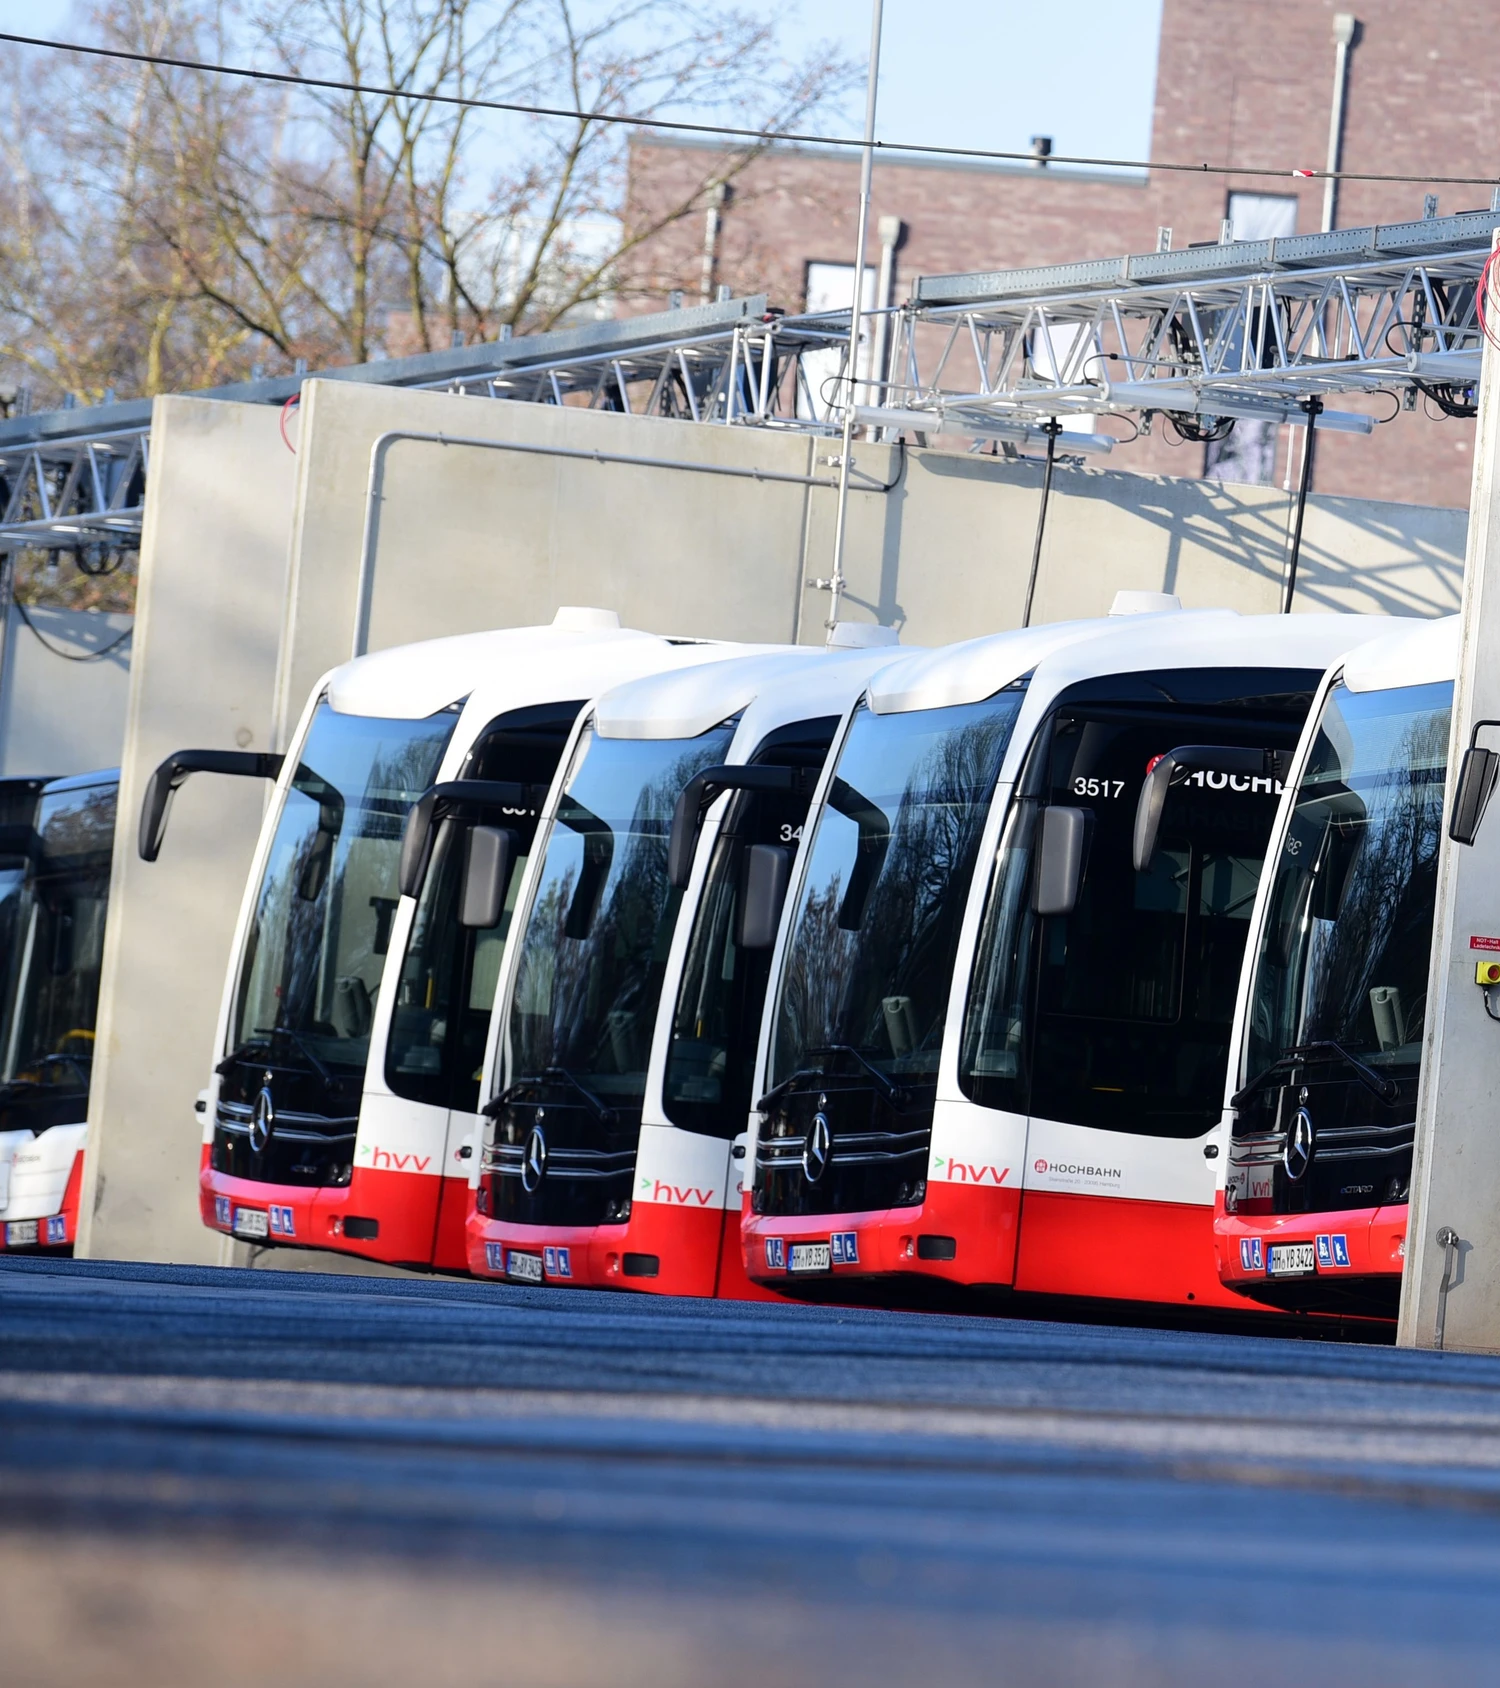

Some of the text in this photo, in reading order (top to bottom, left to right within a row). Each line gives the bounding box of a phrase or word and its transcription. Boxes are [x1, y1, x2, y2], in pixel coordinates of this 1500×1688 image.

[1074, 777, 1125, 798] 3517
[1183, 765, 1285, 795] HOCH
[373, 1147, 431, 1171] hvv
[948, 1158, 1010, 1184] hvv
[1050, 1163, 1122, 1178] HOCHBAHN
[653, 1180, 714, 1205] hvv
[1273, 1248, 1313, 1270] HH YB 3422
